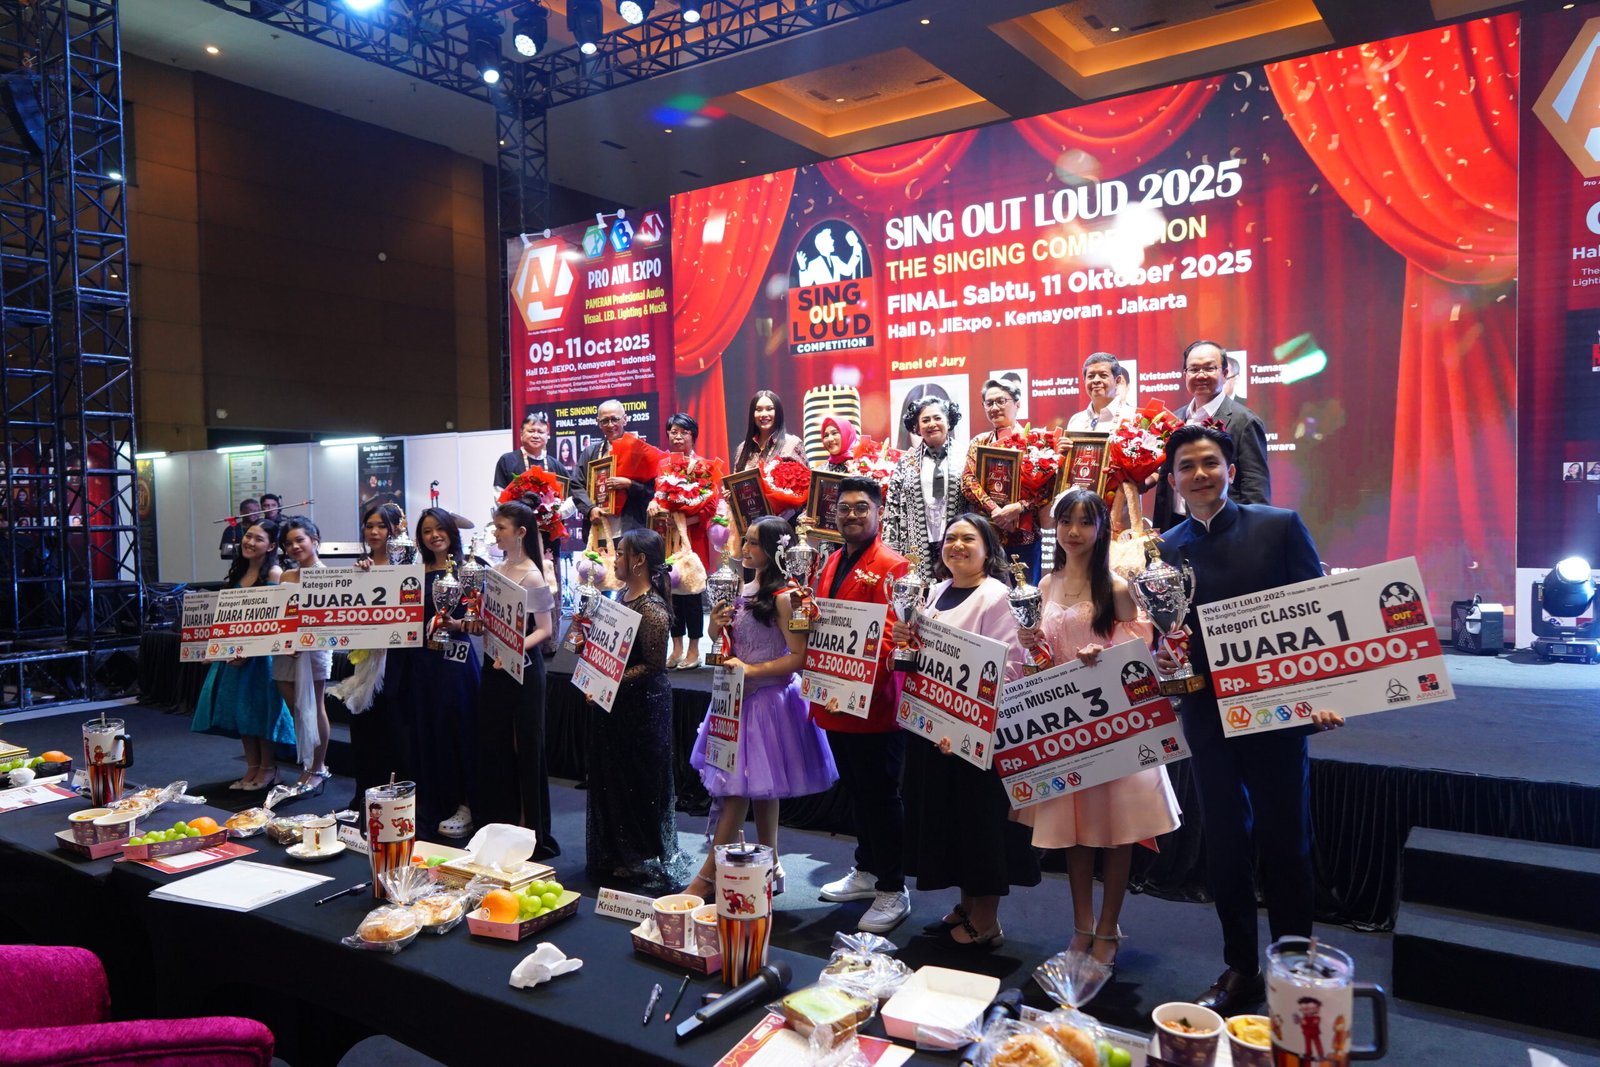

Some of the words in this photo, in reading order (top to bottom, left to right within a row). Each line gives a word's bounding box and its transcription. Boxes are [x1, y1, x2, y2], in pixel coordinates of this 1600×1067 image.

[886, 210, 954, 249] SING
[962, 197, 1026, 237] OUT
[1035, 180, 1128, 227] LOUD
[1139, 159, 1242, 209] 2025
[886, 258, 926, 281] THE
[933, 243, 1025, 275] SINGING
[1032, 215, 1206, 261] COMPION
[1572, 246, 1600, 259] Hal
[588, 268, 609, 289] PRO
[611, 264, 631, 285] AVL
[633, 258, 662, 281] EXPO
[888, 289, 957, 314] FINAL.
[963, 281, 1036, 306] Sabtu,
[1042, 274, 1061, 296] 11
[1068, 264, 1174, 293] Oktober
[1181, 249, 1252, 280] 2025
[1572, 277, 1600, 286] Lighti
[586, 296, 612, 310] PAMERAN
[646, 287, 665, 299] Audio
[798, 283, 860, 311] SING
[618, 306, 642, 320] Lighting
[643, 306, 648, 314] &
[650, 302, 667, 314] Musik
[810, 302, 847, 324] OUT
[888, 322, 916, 339] Hall
[920, 321, 935, 337] D,
[938, 316, 992, 333] JIExpo
[1005, 304, 1103, 326] Kemayoran
[1117, 294, 1187, 315] Jakarta
[793, 314, 871, 342] LOUD
[529, 342, 554, 363] 09
[565, 337, 581, 359] 11
[584, 338, 611, 356] Oct
[614, 334, 650, 352] 2025
[797, 338, 866, 353] COMPETITION
[526, 368, 538, 377] Hall
[539, 366, 550, 375] D2.
[551, 364, 577, 374] JIEXPO,
[578, 359, 616, 370] Kemayoran
[622, 354, 656, 365] Indonesia
[892, 360, 922, 371] Panel
[925, 359, 937, 368] of
[940, 356, 966, 367] Jury
[1032, 378, 1053, 387] Head
[1055, 378, 1074, 387] Jury
[1140, 371, 1182, 381] Kristanto
[1032, 388, 1056, 397] David
[1058, 387, 1079, 395] Klein
[556, 408, 569, 417] THE
[570, 406, 597, 416] SINGING
[624, 401, 647, 411] TITION
[633, 413, 650, 422] 2025
[1265, 432, 1278, 441] yu
[1267, 443, 1296, 451] swara
[302, 580, 333, 590] Kategori
[335, 579, 352, 588] POP
[302, 593, 366, 608] JUARA
[372, 587, 387, 605] 2
[1202, 605, 1220, 615] SING
[1222, 602, 1239, 610] OUT
[1240, 597, 1262, 607] LOUD
[1263, 591, 1285, 602] 2025
[183, 614, 203, 626] JUARA
[204, 613, 214, 625] FAV
[215, 608, 242, 622] JUARA
[245, 606, 279, 620] FAVORIT
[302, 615, 320, 625] Rp.
[324, 608, 417, 623] 2.500.000,-
[506, 604, 512, 626] 3
[1206, 616, 1258, 637] Kategori
[1261, 600, 1322, 625] CLASSIC
[1237, 603, 1271, 615] Competition
[1392, 611, 1412, 620] OUT
[212, 628, 225, 637] Rp.
[228, 622, 286, 635] 500.000,-
[831, 615, 852, 628] MUSICAL
[194, 629, 210, 638] 500
[609, 630, 620, 652] 3
[809, 630, 844, 653] JUARA
[847, 630, 858, 655] 2
[1214, 626, 1326, 667] JUARA
[1328, 610, 1350, 642] 1
[935, 638, 960, 660] CLASSIC
[806, 655, 816, 667] Rp.
[818, 654, 871, 682] 2.500.000,-
[1219, 677, 1251, 693] Rp.
[1256, 638, 1429, 685] 5.000.000,-
[956, 664, 970, 692] 2
[1005, 684, 1024, 695] LOUD
[1025, 677, 1044, 688] 2025
[999, 702, 1024, 719] egori
[1025, 682, 1080, 709] MUSICAL
[1004, 689, 1032, 702] Competition
[1133, 685, 1149, 696] OUT
[906, 678, 917, 692] Rp.
[920, 679, 988, 727] 2.500.000,-
[994, 705, 1083, 750] JUARA
[1082, 687, 1109, 717] 3
[1000, 758, 1027, 772] Rp.
[1028, 709, 1161, 762] 1.000.000,-
[598, 901, 633, 916] Kristanto
[635, 909, 656, 920] Panti
